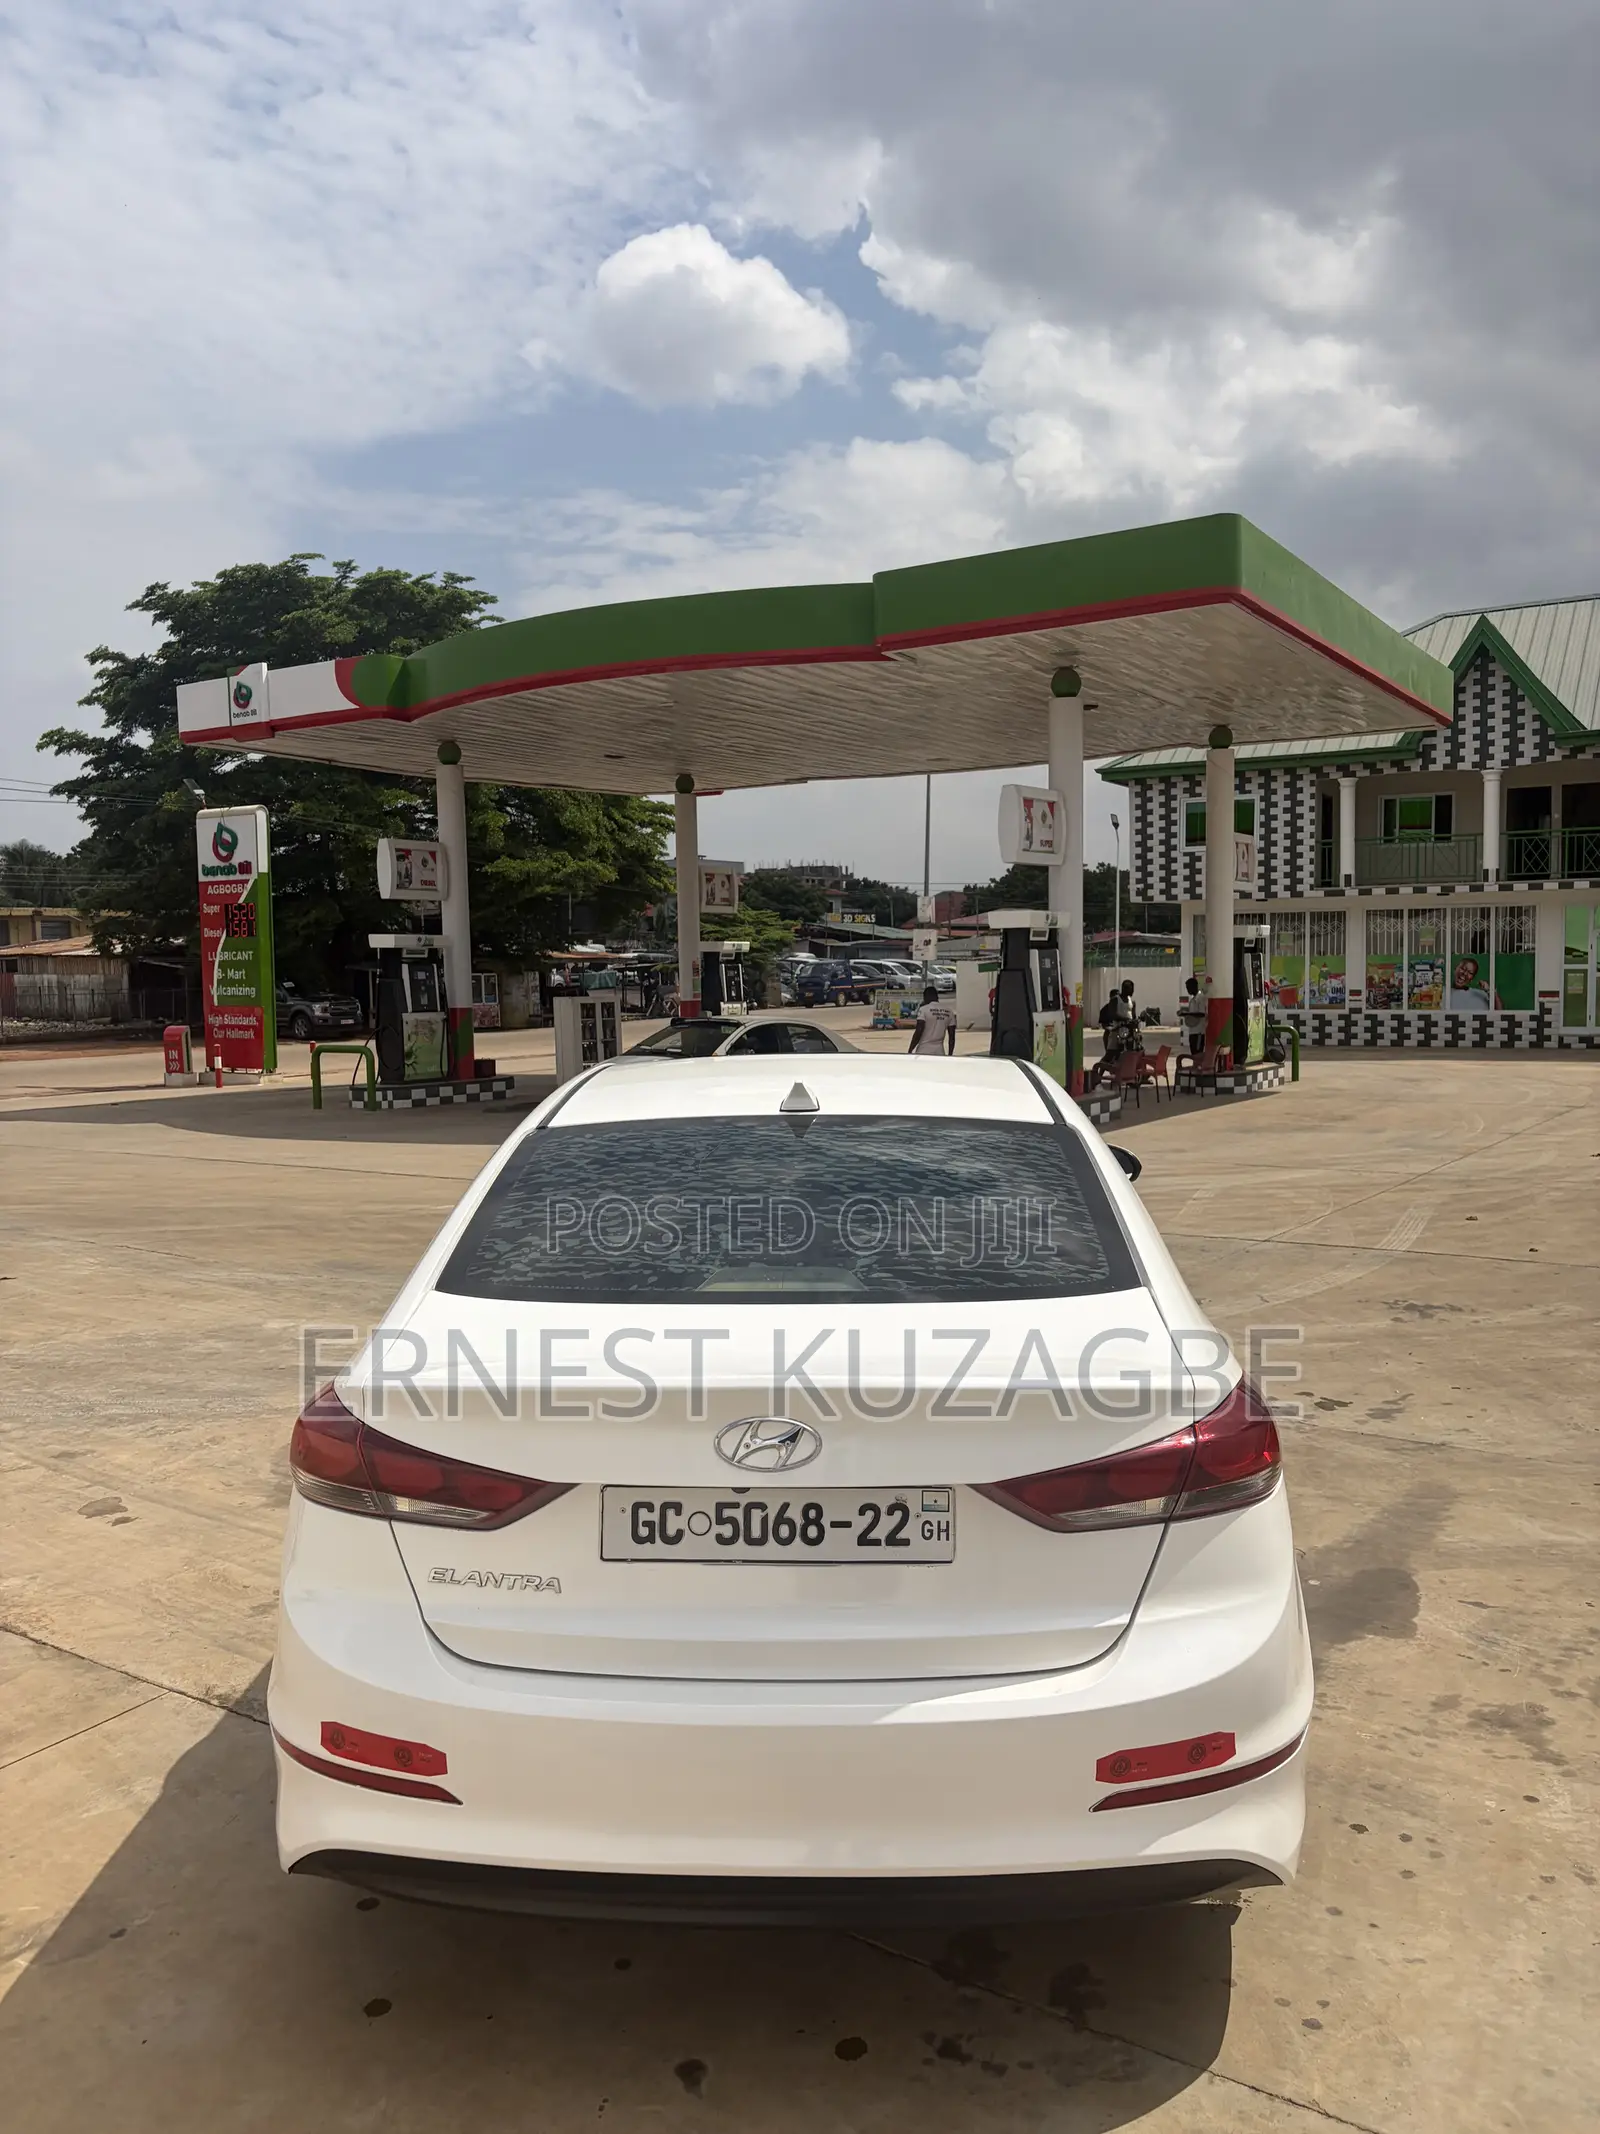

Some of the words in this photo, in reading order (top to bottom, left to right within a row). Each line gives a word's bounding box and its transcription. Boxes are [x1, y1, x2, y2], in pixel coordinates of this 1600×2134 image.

[202, 903, 221, 916] Super
[843, 914, 853, 923] 3D
[854, 913, 876, 923] SIGNS
[203, 927, 223, 938] Diesel
[208, 951, 254, 961] LUBRICANT
[227, 968, 246, 980] Mart
[209, 983, 256, 998] Vulcanizing
[208, 1014, 223, 1027] High
[213, 1027, 225, 1039] Our
[226, 1028, 255, 1039] Hallmark
[168, 1050, 179, 1060] IN
[630, 1501, 685, 1546] GC
[715, 1501, 911, 1547] 5068-22
[920, 1519, 950, 1542] GH
[428, 1567, 562, 1594] ELANTRA
